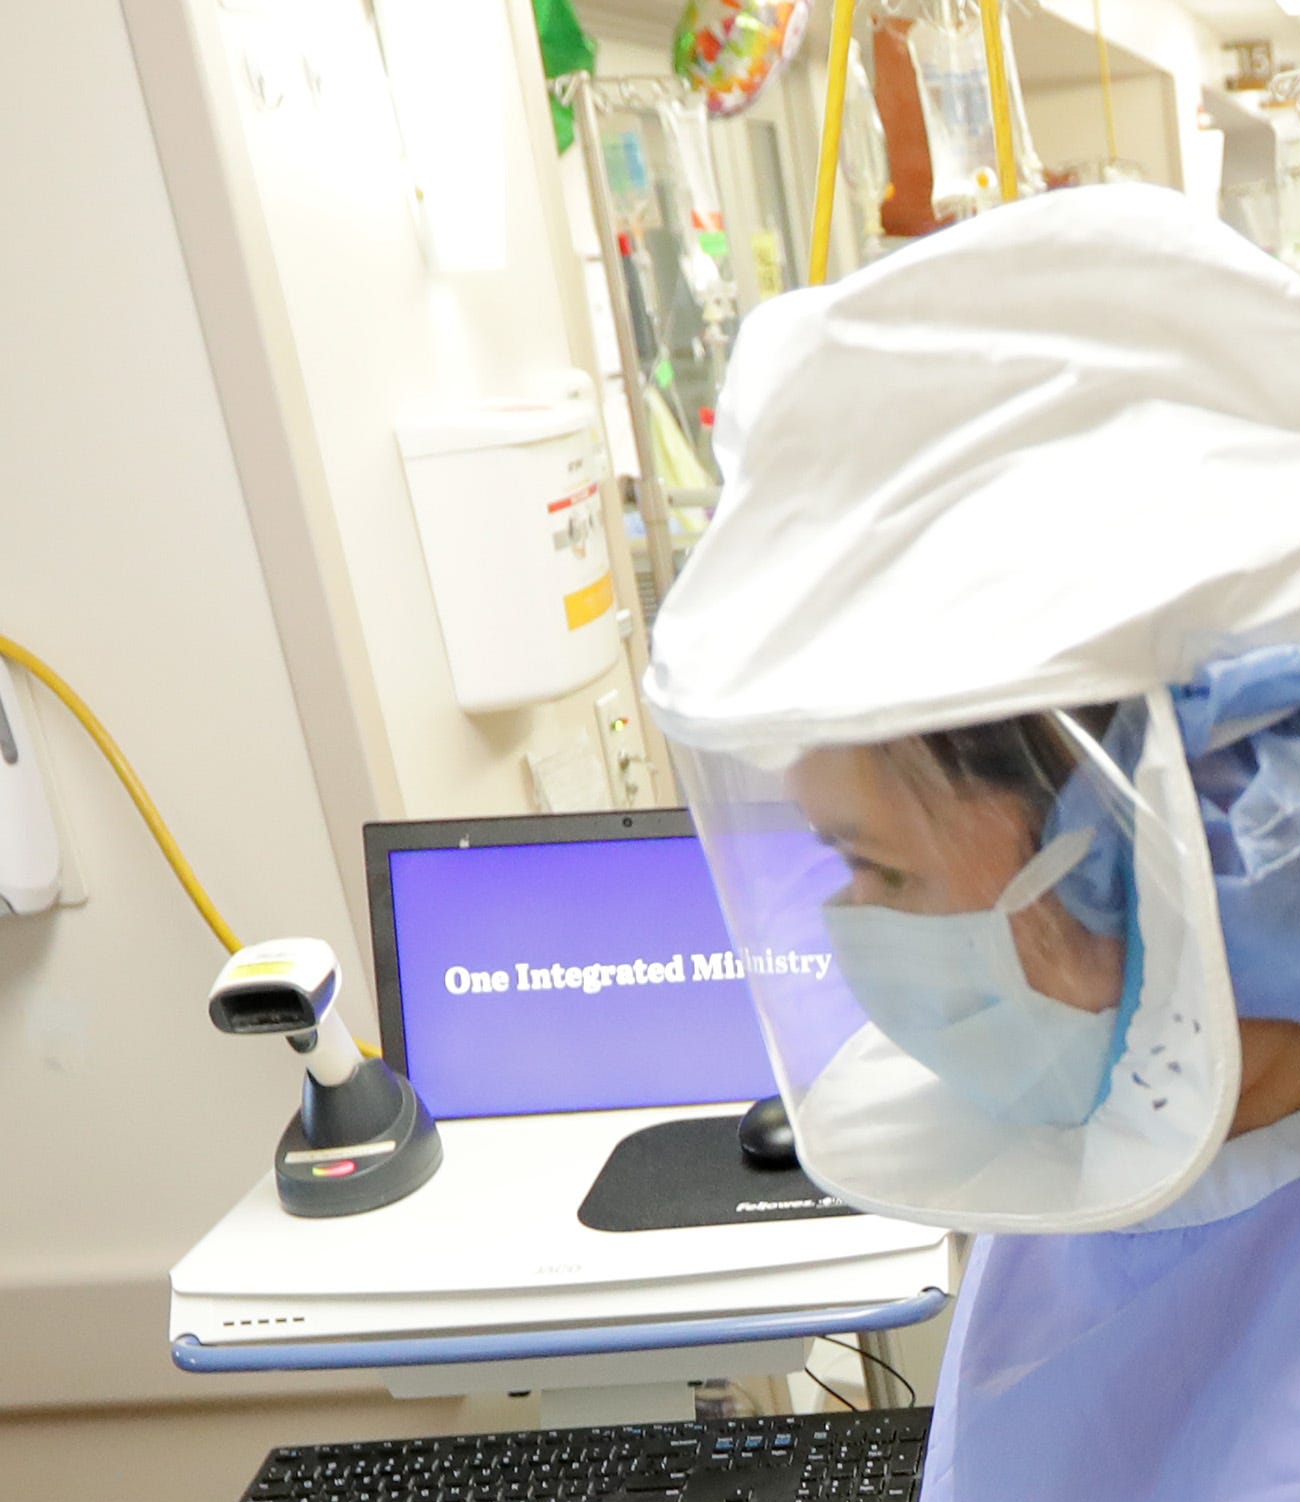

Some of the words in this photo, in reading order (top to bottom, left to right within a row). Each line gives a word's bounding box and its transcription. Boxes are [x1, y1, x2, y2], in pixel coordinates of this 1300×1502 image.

[444, 965, 510, 995] One
[515, 954, 686, 995] Integrated
[692, 948, 833, 981] Ministry
